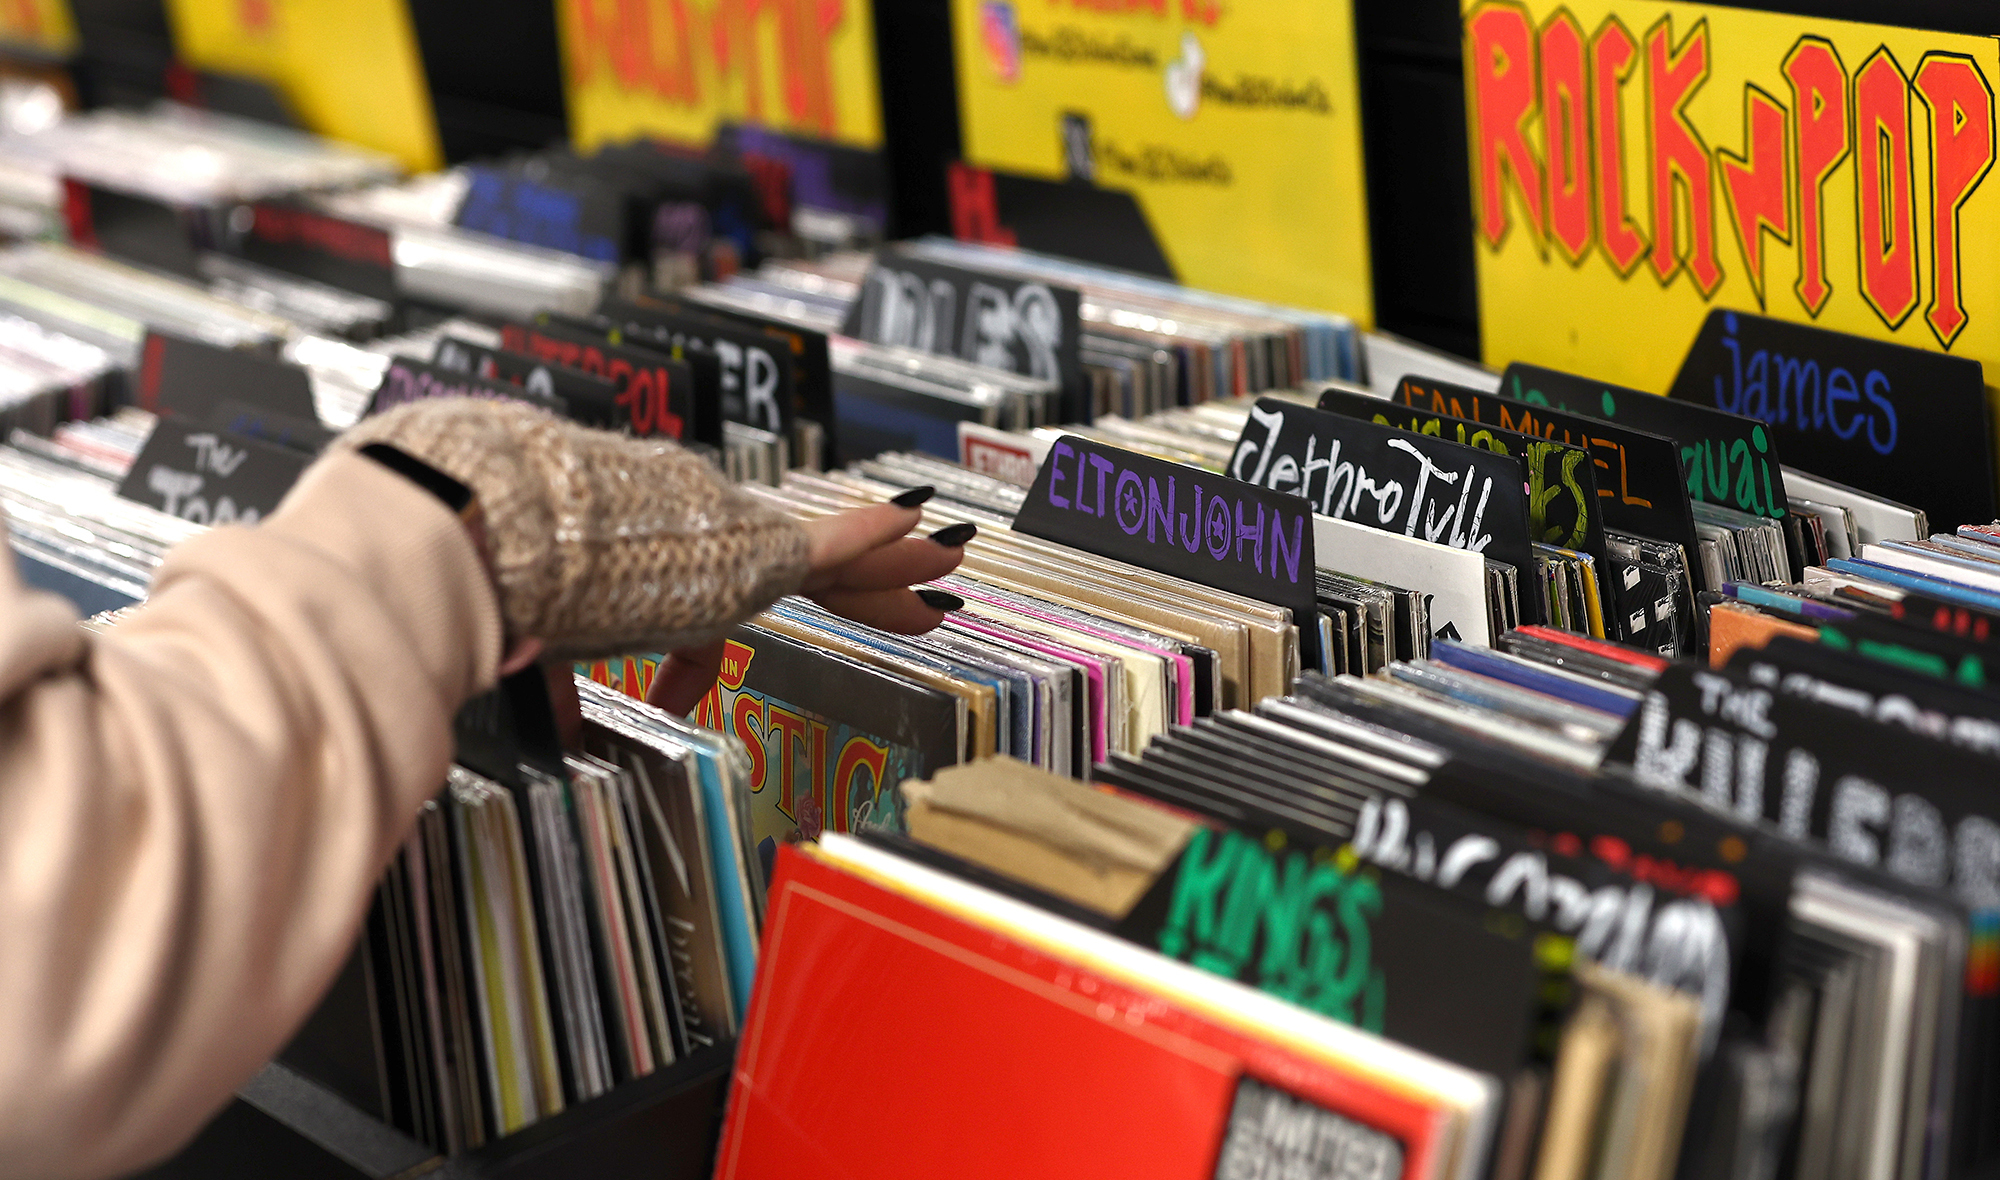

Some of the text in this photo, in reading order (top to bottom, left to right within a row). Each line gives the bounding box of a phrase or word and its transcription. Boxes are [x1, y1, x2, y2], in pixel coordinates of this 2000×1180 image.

[1464, 0, 1997, 351] ROCK POP
[1714, 311, 1898, 454] james
